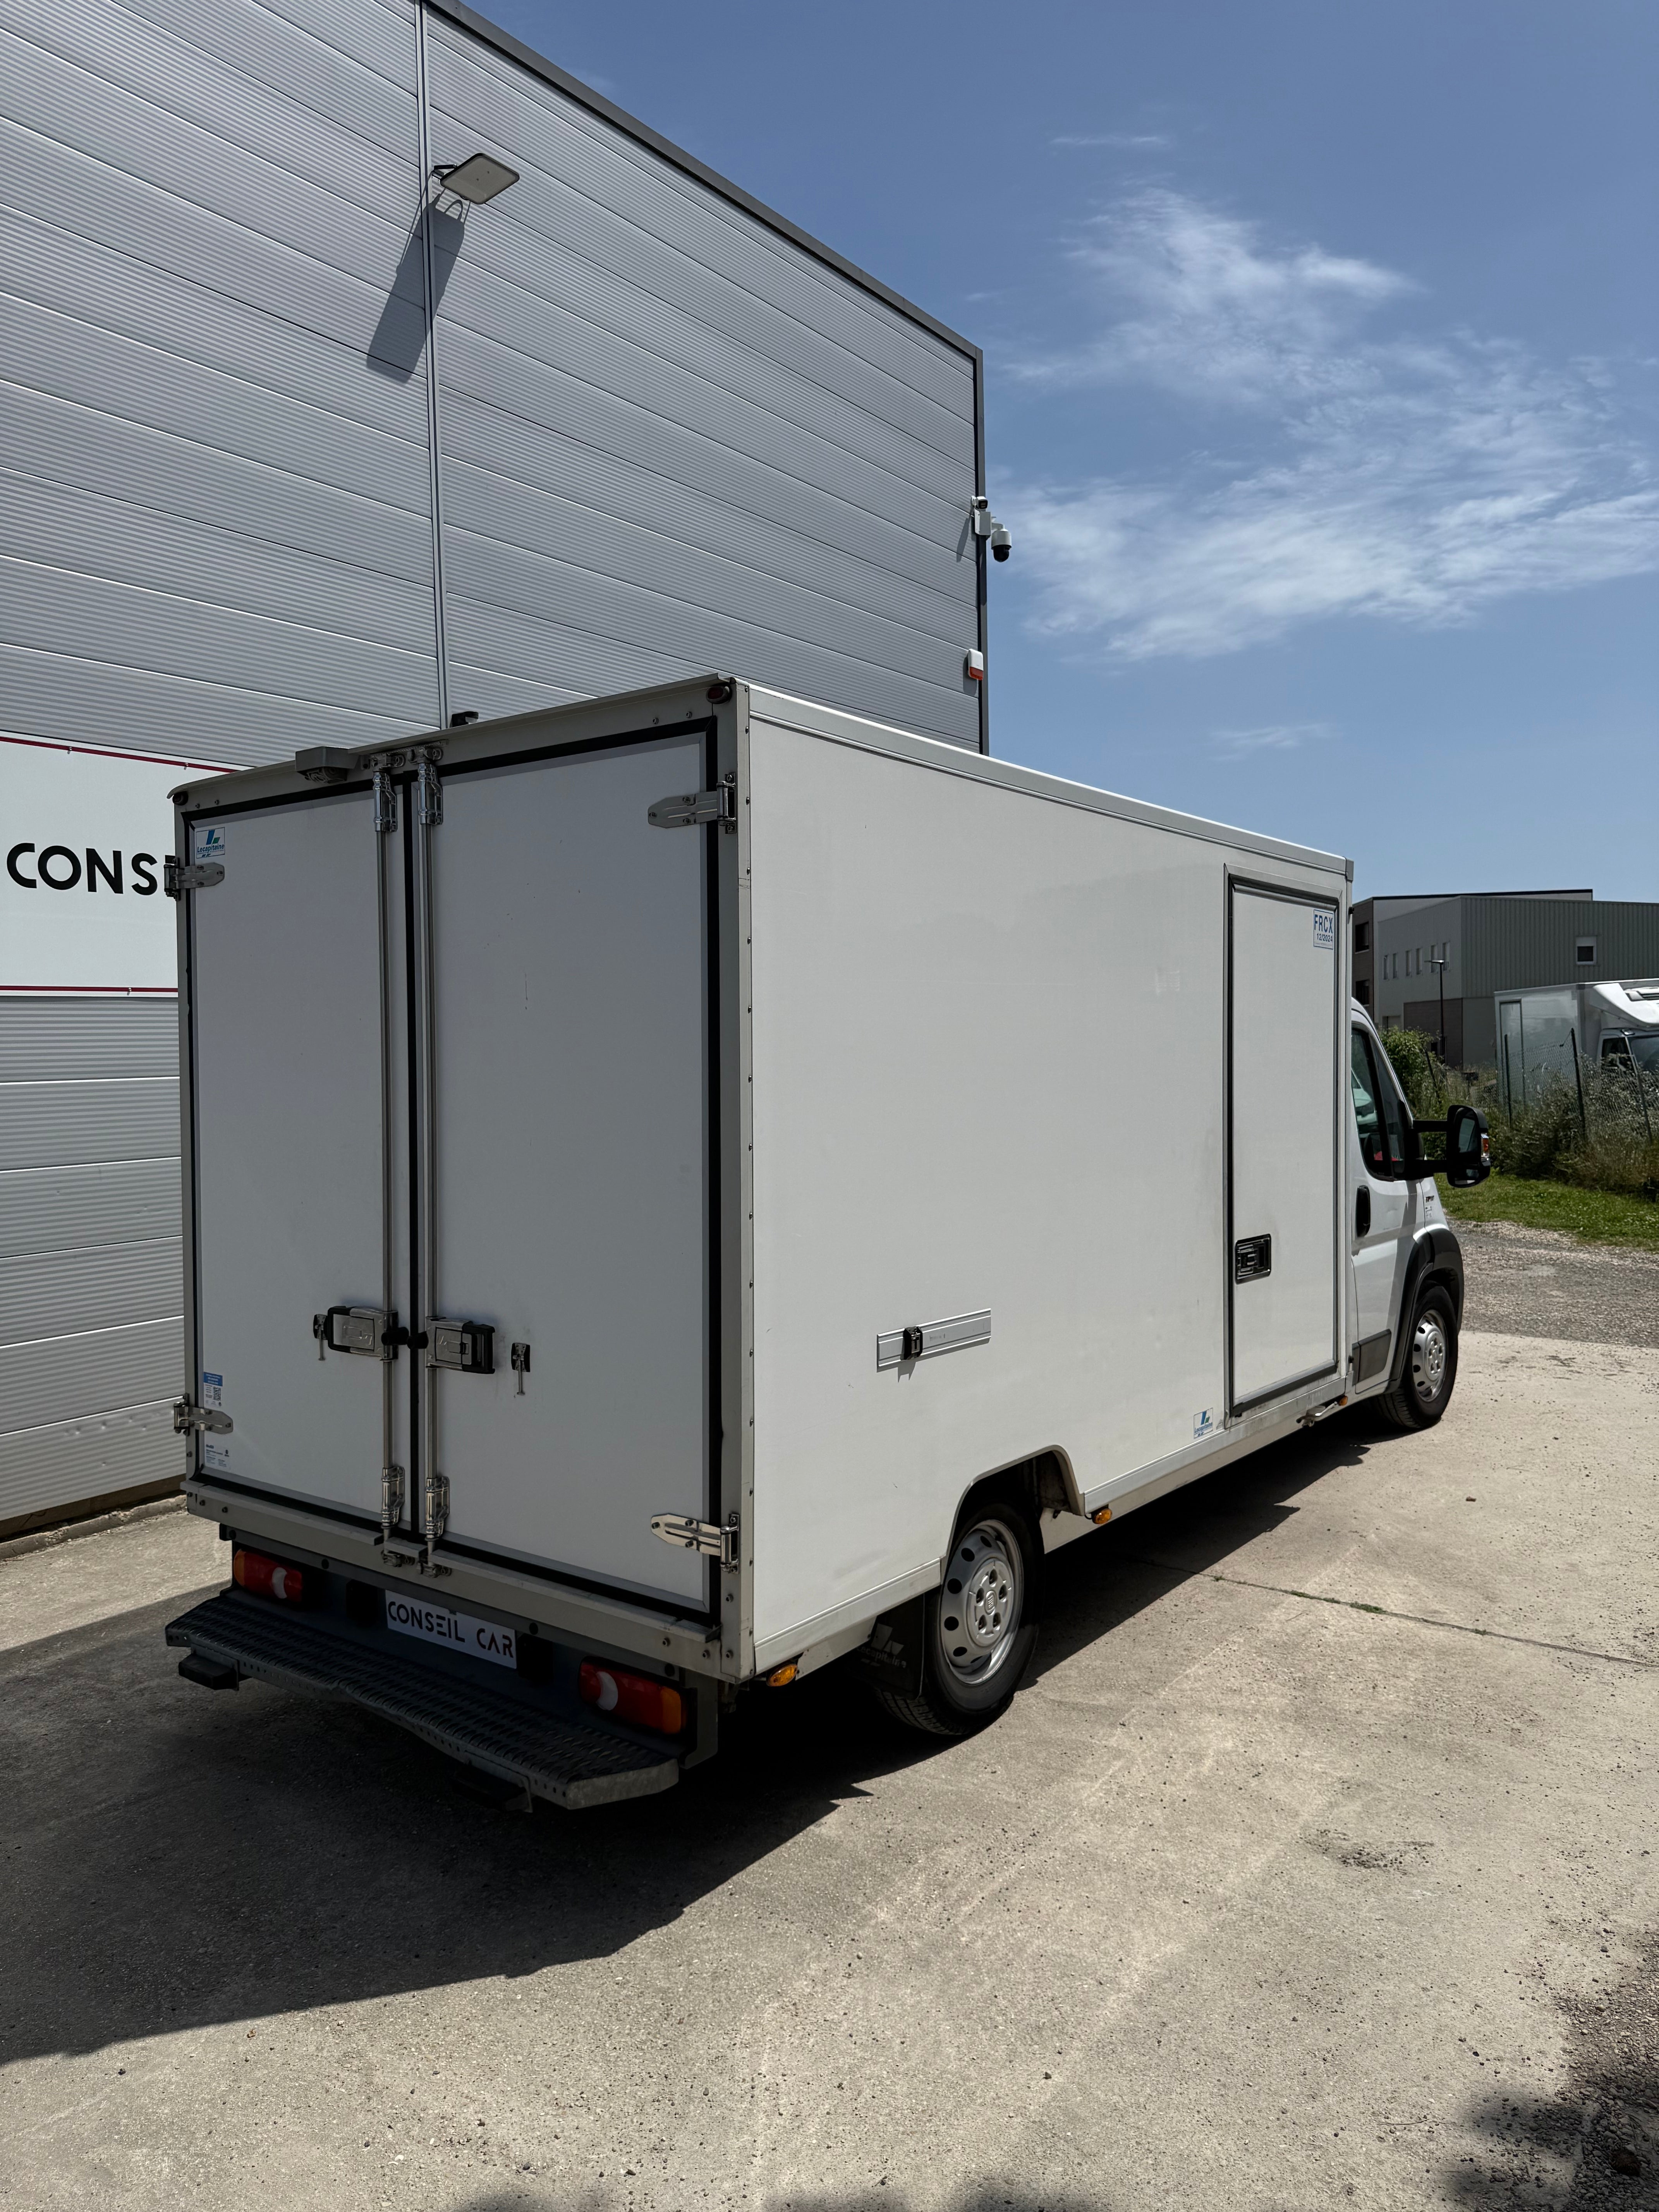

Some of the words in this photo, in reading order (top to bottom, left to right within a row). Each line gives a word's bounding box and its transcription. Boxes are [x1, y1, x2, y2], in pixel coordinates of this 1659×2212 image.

[197, 844, 224, 854] Lecapitaine
[1314, 914, 1333, 933] FRCX
[388, 1601, 465, 1643] CONSEIL
[477, 1628, 514, 1658] CAR
